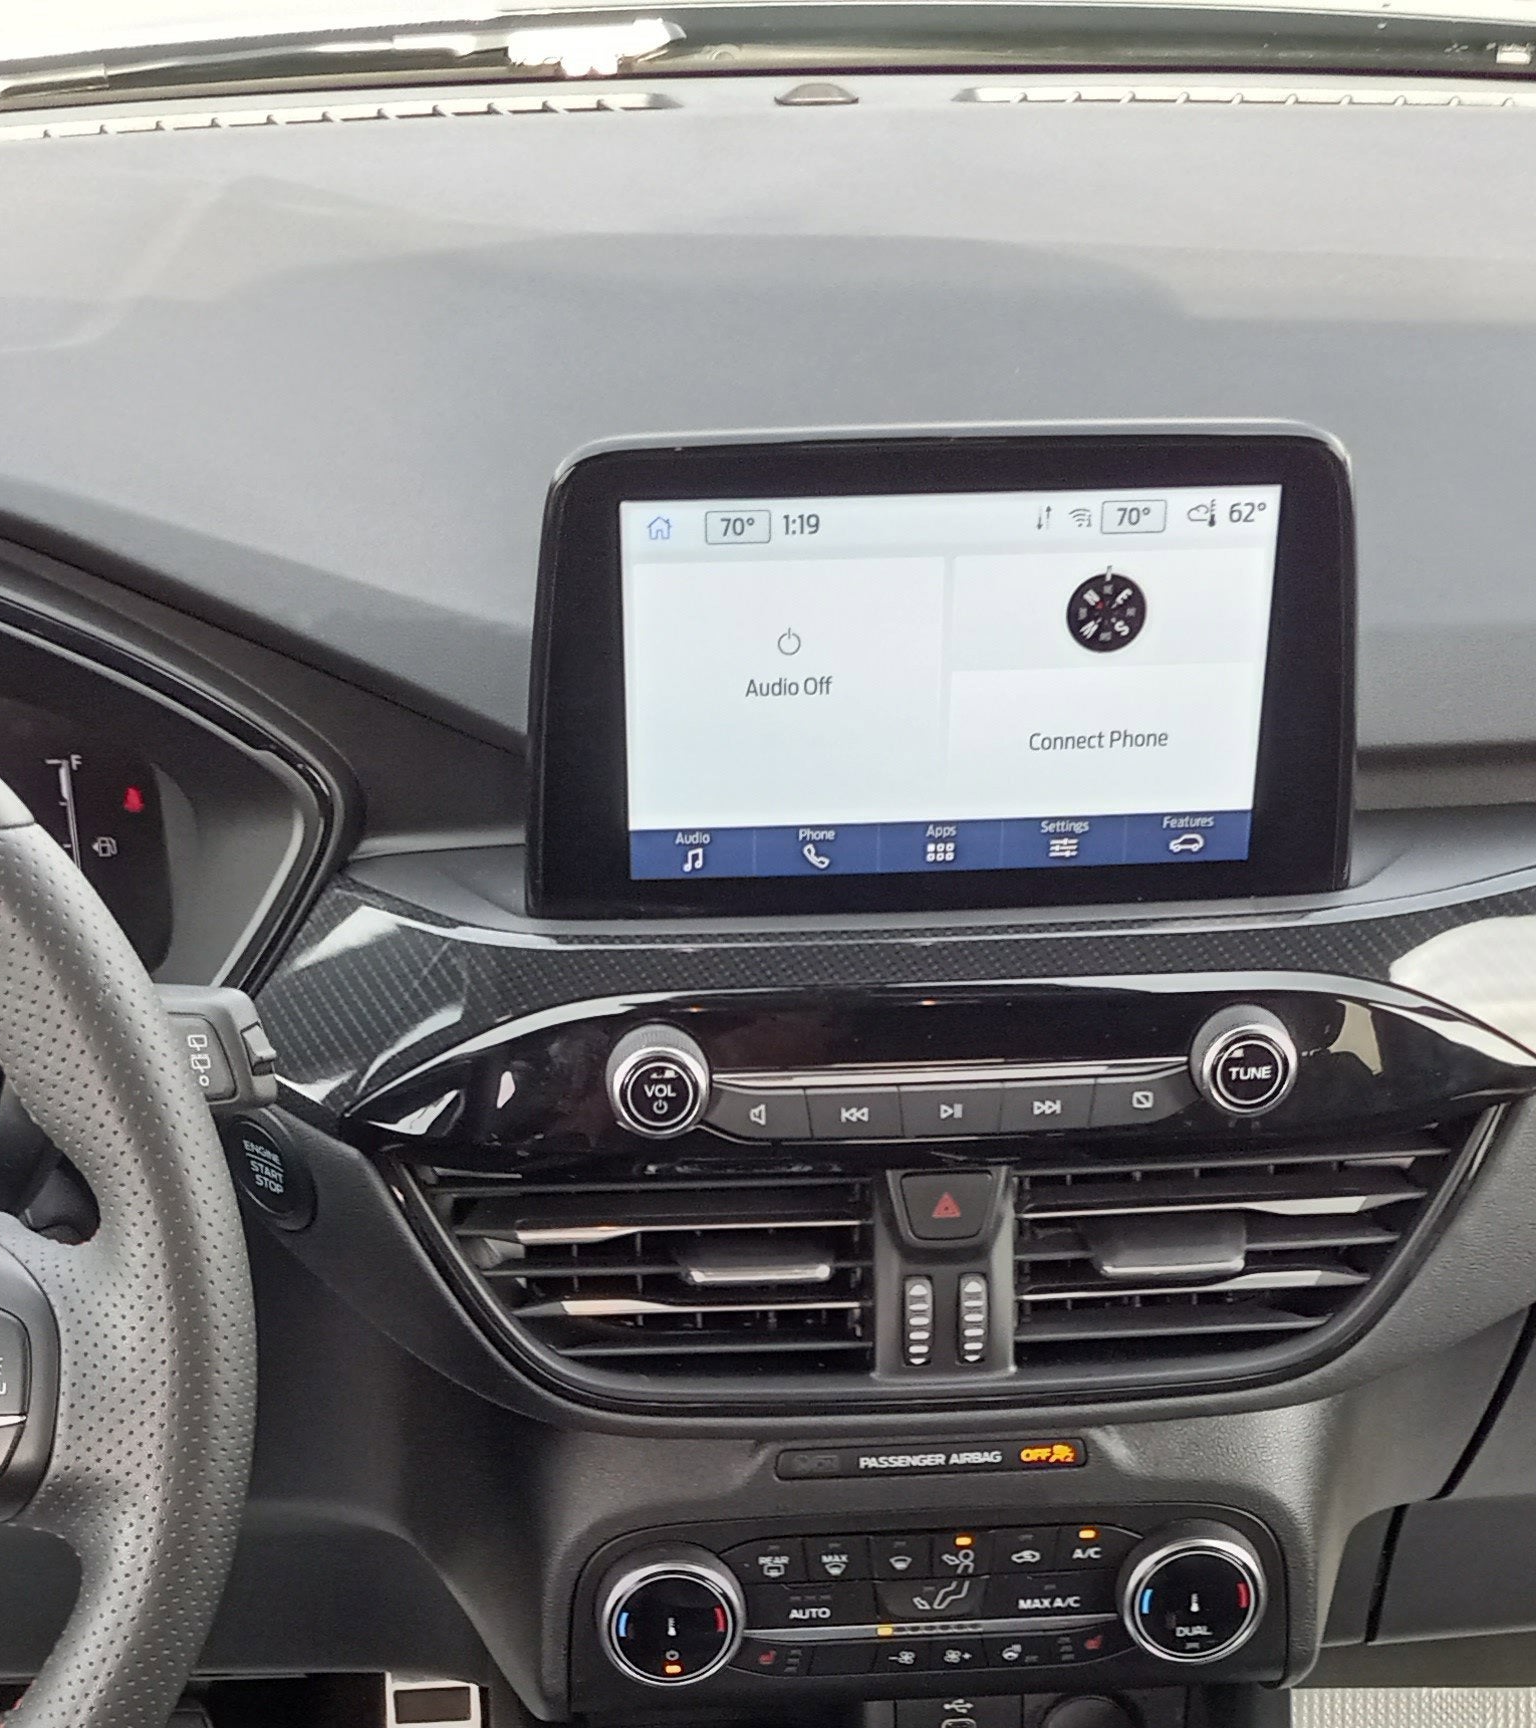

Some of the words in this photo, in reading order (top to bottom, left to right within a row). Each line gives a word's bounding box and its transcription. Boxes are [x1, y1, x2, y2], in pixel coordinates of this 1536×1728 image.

[782, 513, 821, 537] 1:19
[745, 676, 800, 698] Audio
[803, 675, 833, 696] Off
[1029, 730, 1105, 752] Connect
[1110, 728, 1169, 750] Phone
[1041, 819, 1090, 836] Settings
[1163, 814, 1215, 830] Features
[675, 831, 711, 846] Audio
[798, 827, 836, 843] Phone
[926, 824, 957, 840] Apps
[1228, 1065, 1273, 1081] TUNE
[644, 1084, 677, 1098] VOL
[243, 1140, 282, 1166] ENGINE
[250, 1160, 284, 1184] START
[255, 1174, 284, 1195] STOP
[859, 1453, 946, 1470] PASSENGER
[948, 1450, 1003, 1465] AIRBAG
[758, 1556, 790, 1566] REAR
[821, 1553, 849, 1564] MAX
[1072, 1547, 1102, 1559] A/C
[1018, 1597, 1051, 1610] MAX
[1053, 1595, 1081, 1608] A/C
[789, 1607, 831, 1620] AUTO
[1175, 1625, 1213, 1637] DUAL
